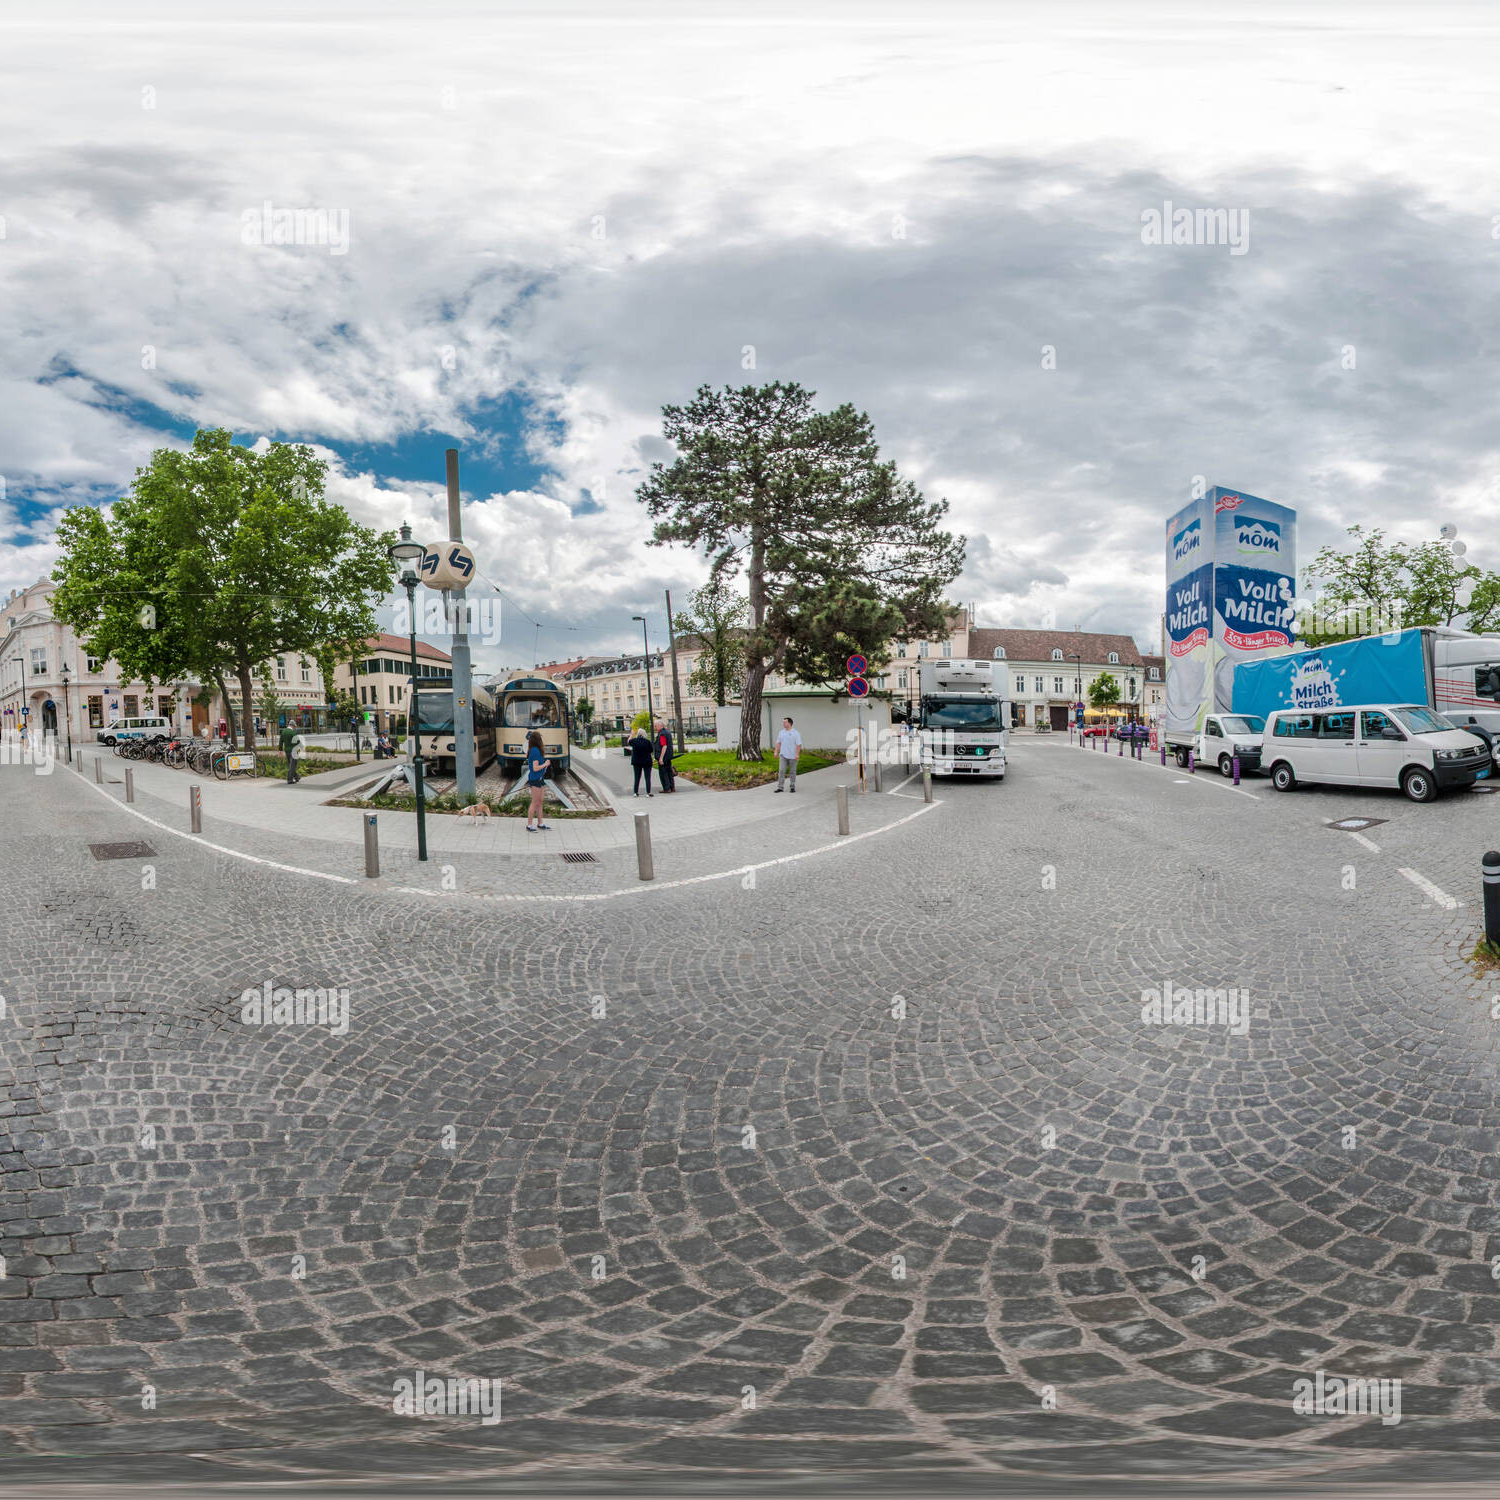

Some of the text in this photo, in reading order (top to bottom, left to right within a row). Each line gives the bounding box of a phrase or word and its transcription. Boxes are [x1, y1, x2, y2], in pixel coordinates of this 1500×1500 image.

[1175, 580, 1200, 608] Voll
[1238, 578, 1278, 603] Voll
[1169, 601, 1208, 633] Milch
[1224, 598, 1289, 629] Milch
[1295, 681, 1332, 700] Milch
